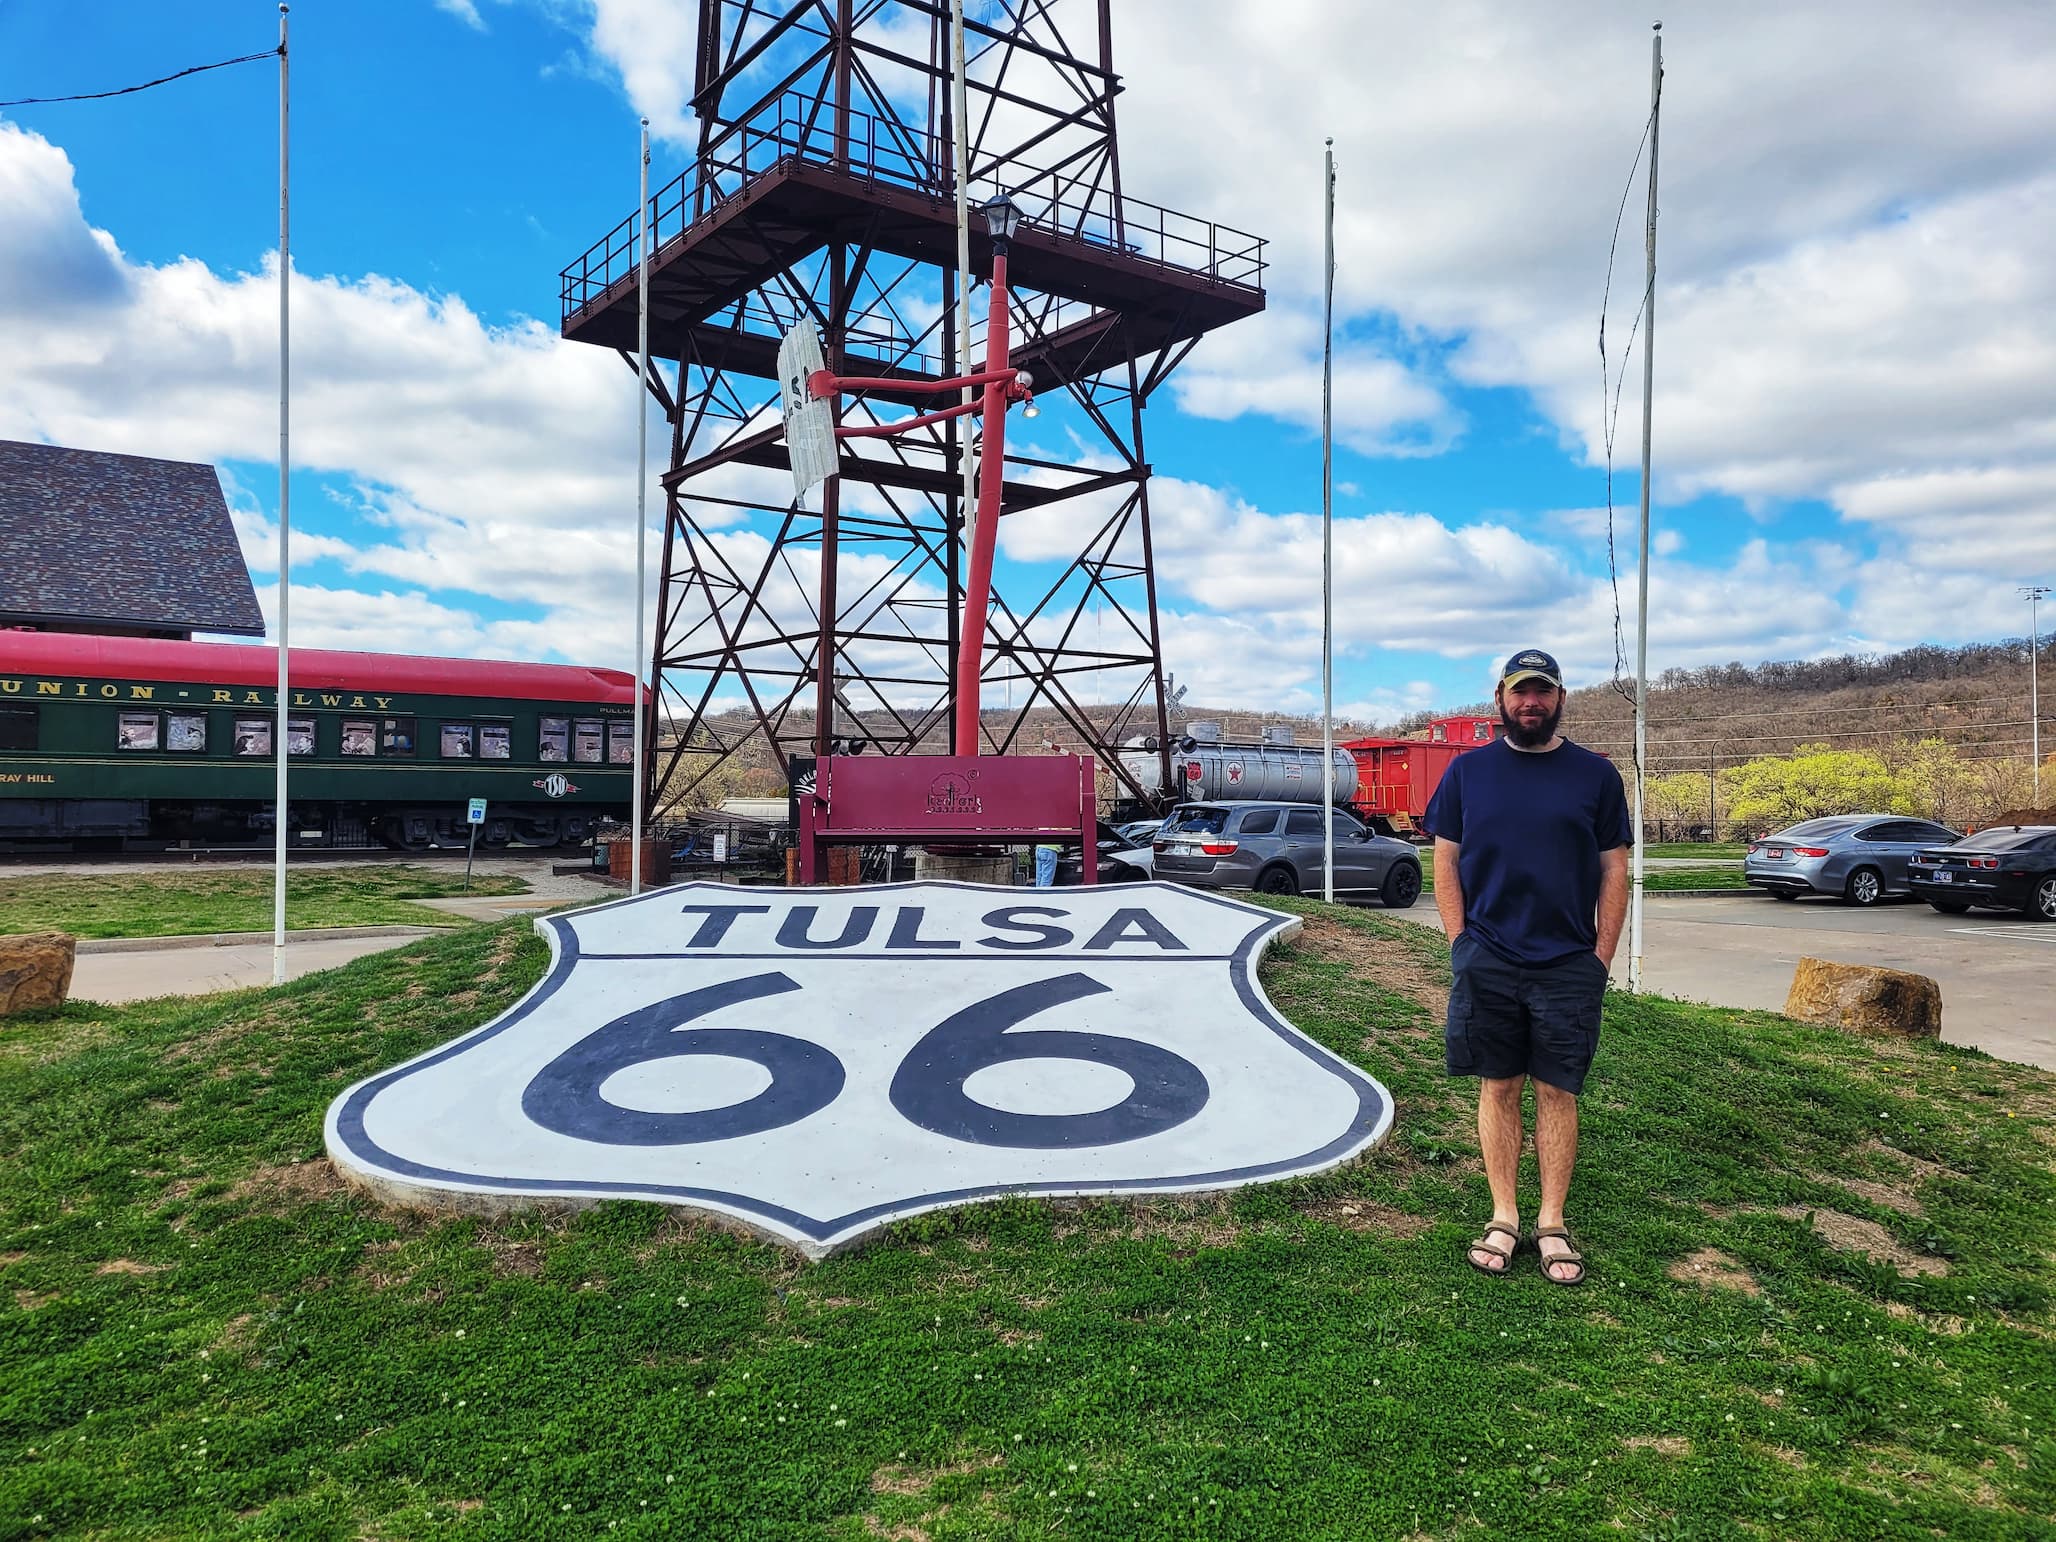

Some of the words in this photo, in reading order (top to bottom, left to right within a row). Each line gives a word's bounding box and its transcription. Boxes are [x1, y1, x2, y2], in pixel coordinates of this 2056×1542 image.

[0, 680, 155, 699] UNION
[0, 774, 22, 784] RAY
[27, 774, 55, 784] HILL
[681, 904, 1190, 951] TULSA
[521, 971, 1211, 1150] 66
